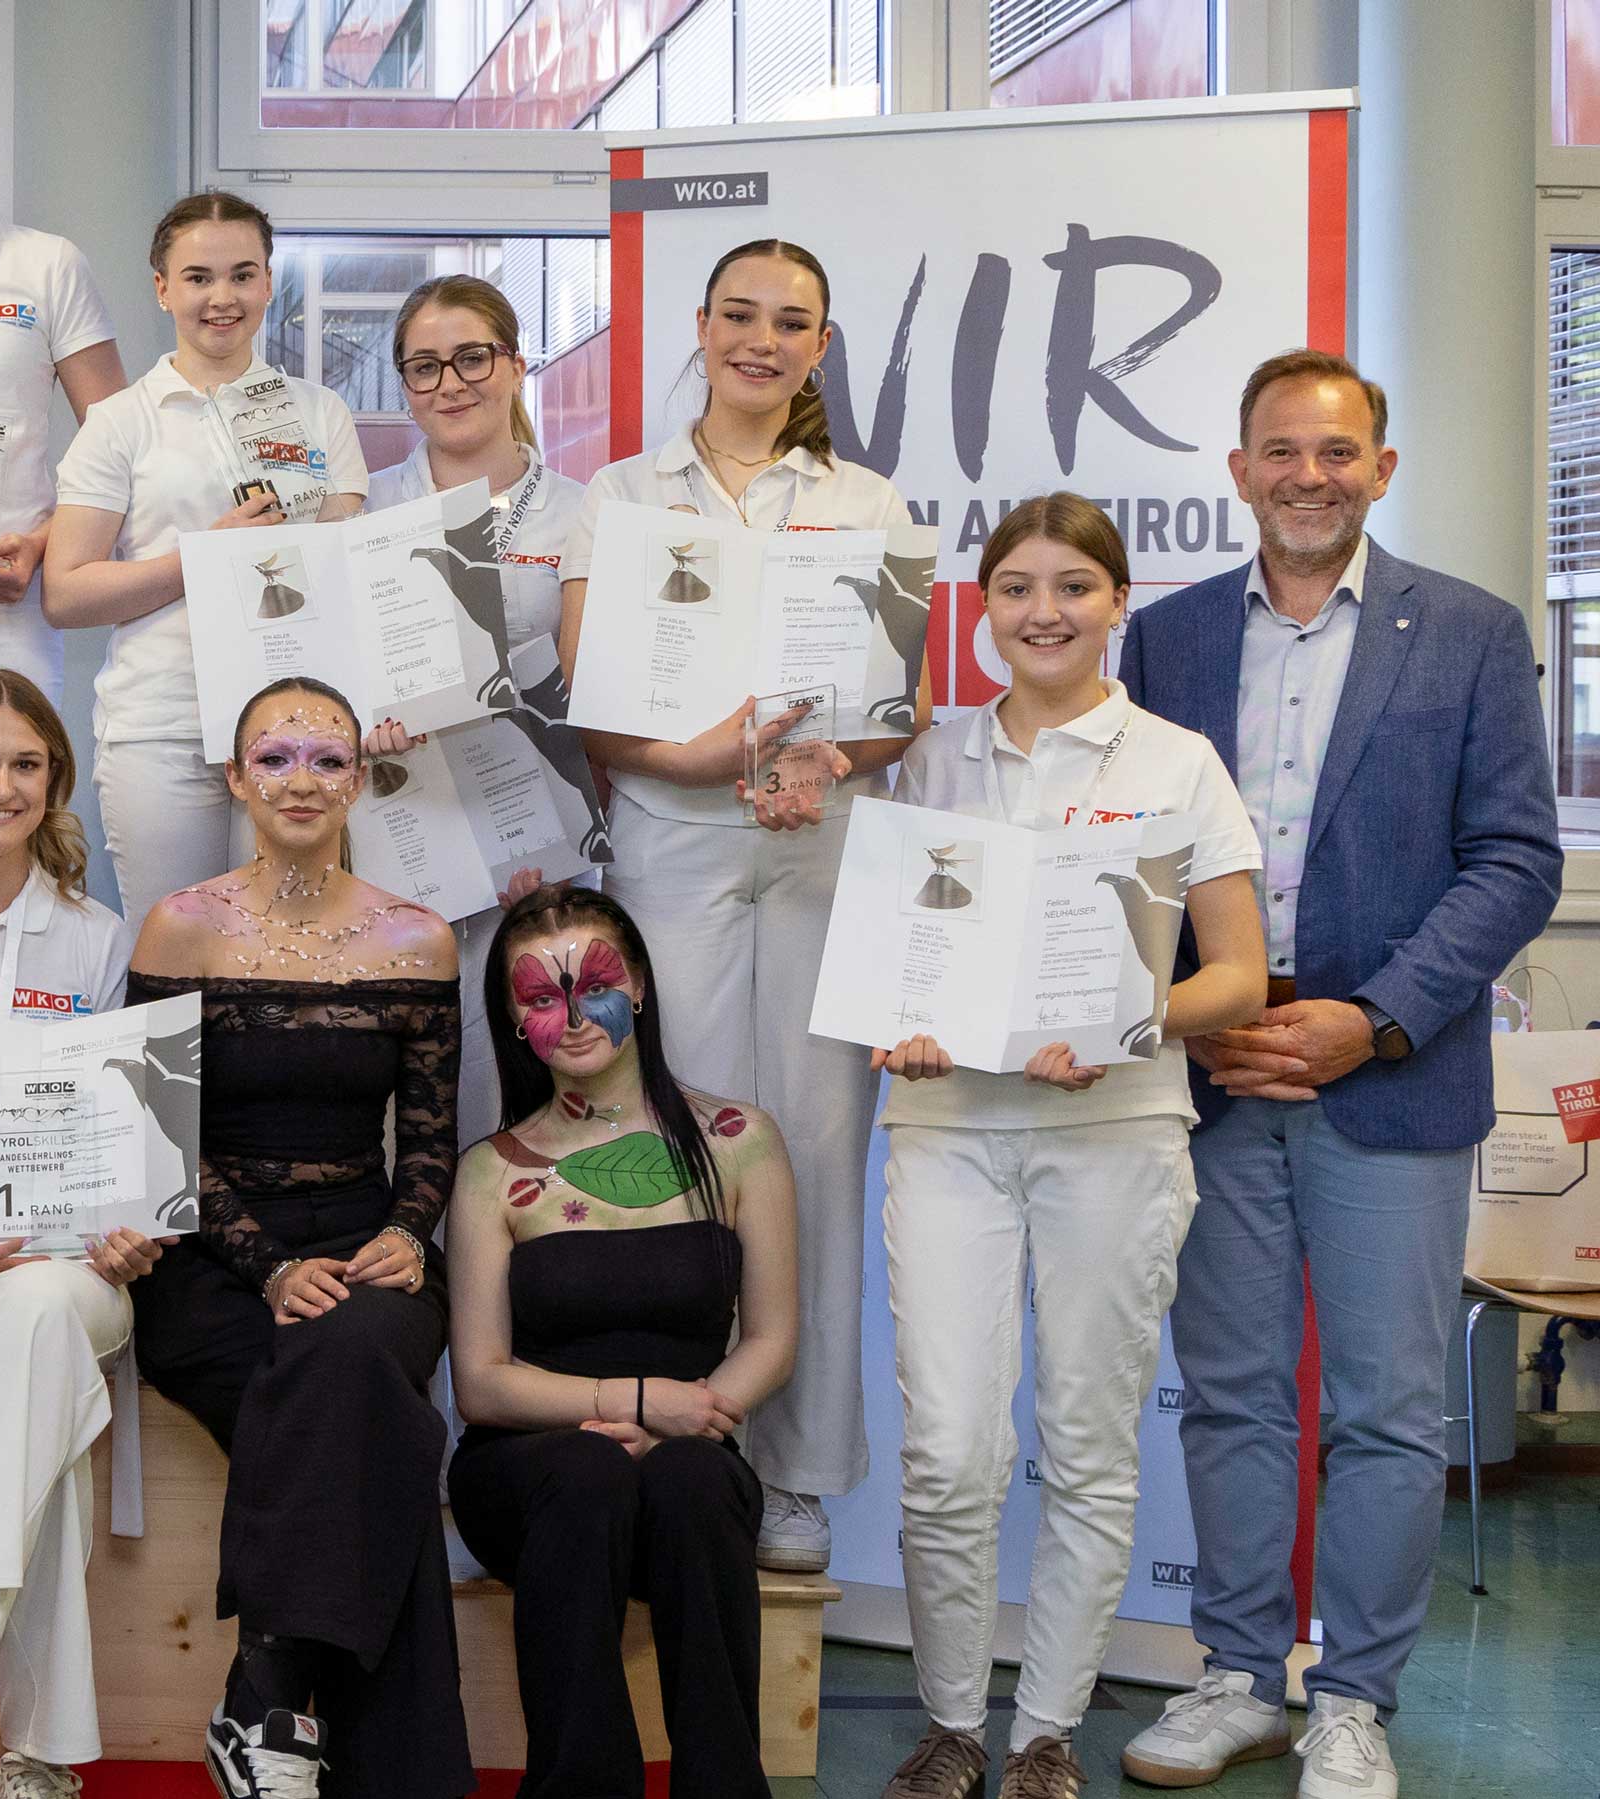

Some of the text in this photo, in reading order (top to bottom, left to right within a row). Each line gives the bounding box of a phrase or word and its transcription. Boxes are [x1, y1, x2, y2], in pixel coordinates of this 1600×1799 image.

[674, 180, 757, 202] WKO.at
[244, 380, 275, 397] WKO
[293, 486, 327, 504] RANG
[508, 478, 537, 529] SCHAUEN
[497, 526, 513, 551] AUF
[504, 554, 560, 567] WKO
[765, 771, 822, 794] 3. RANG
[14, 989, 70, 1011] WKO
[25, 1082, 63, 1094] WKO
[1560, 1084, 1594, 1101] JA ZU
[1519, 1131, 1547, 1140] steckt
[1491, 1141, 1556, 1152] echter Tiroler
[1491, 1153, 1559, 1164] Unternehmer-
[7, 1163, 65, 1173] WETTBEWERB
[59, 1177, 117, 1193] LANDESBESTE
[30, 1203, 74, 1216] RANG
[2, 1223, 34, 1232] Fantasie
[1576, 1247, 1600, 1259] WK
[1153, 1563, 1195, 1583] WK
